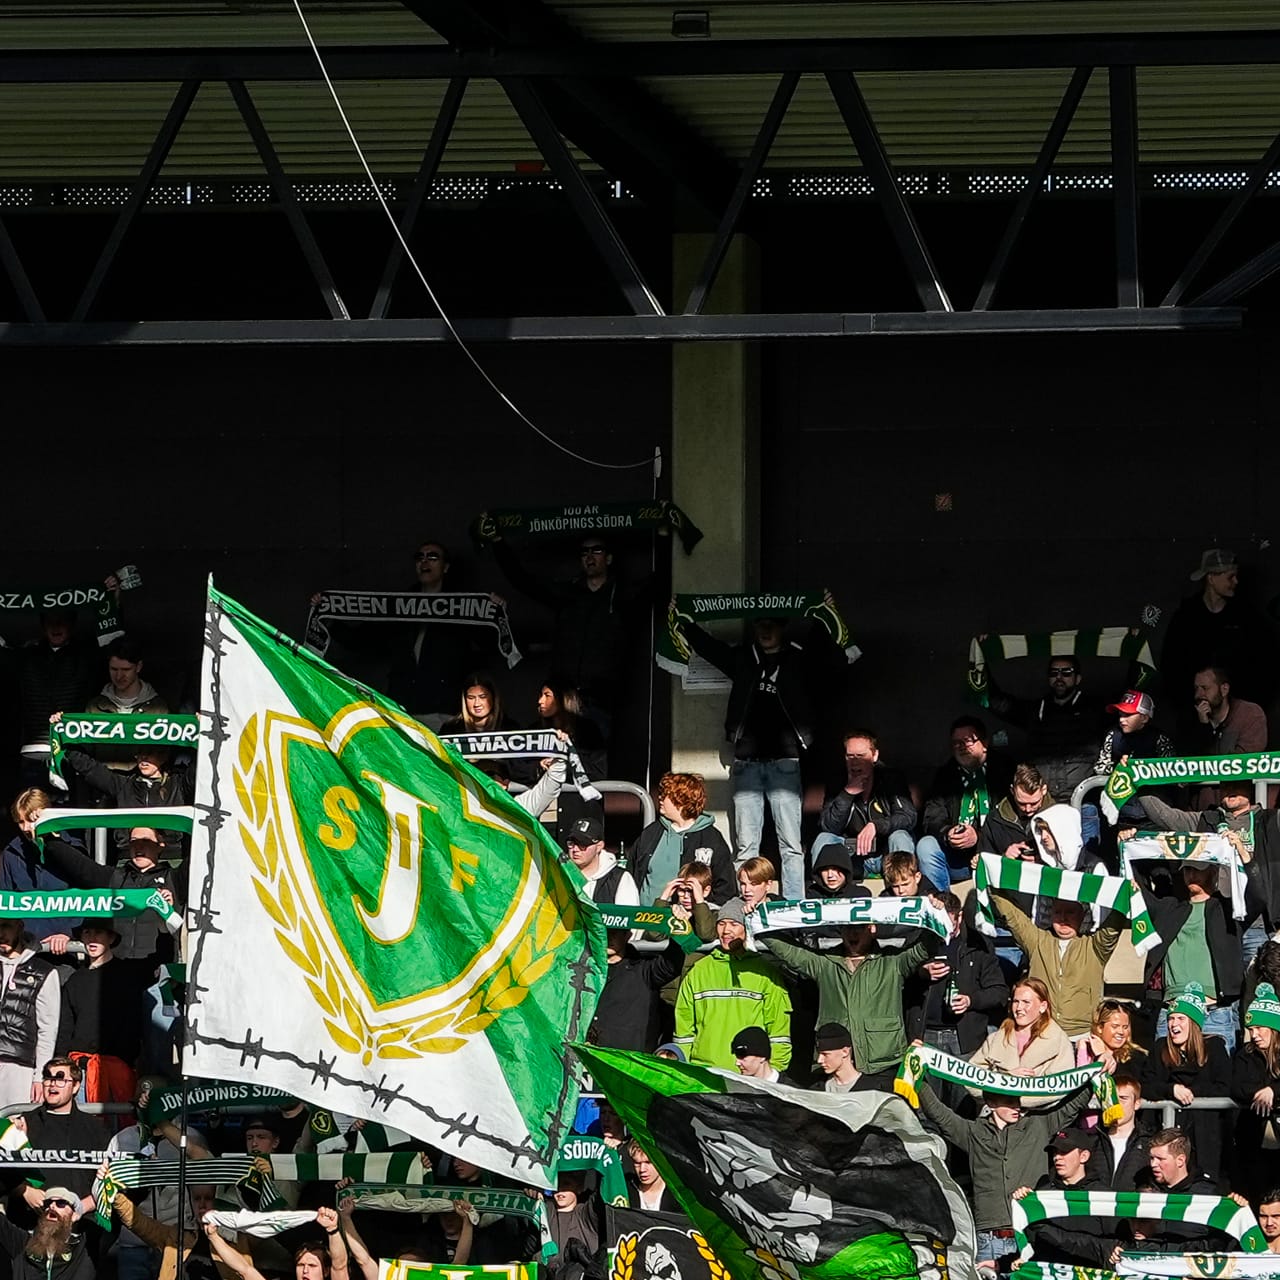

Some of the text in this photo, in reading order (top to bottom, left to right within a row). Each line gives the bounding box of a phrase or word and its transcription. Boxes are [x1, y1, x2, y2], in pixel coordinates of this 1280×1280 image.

[320, 596, 498, 620] GREEN MACHINE
[692, 597, 754, 614] JÖNKÖPINGS
[756, 594, 792, 611] SÖDRA
[1132, 756, 1244, 782] JÖNKÖPINGS
[634, 911, 664, 926] 2022
